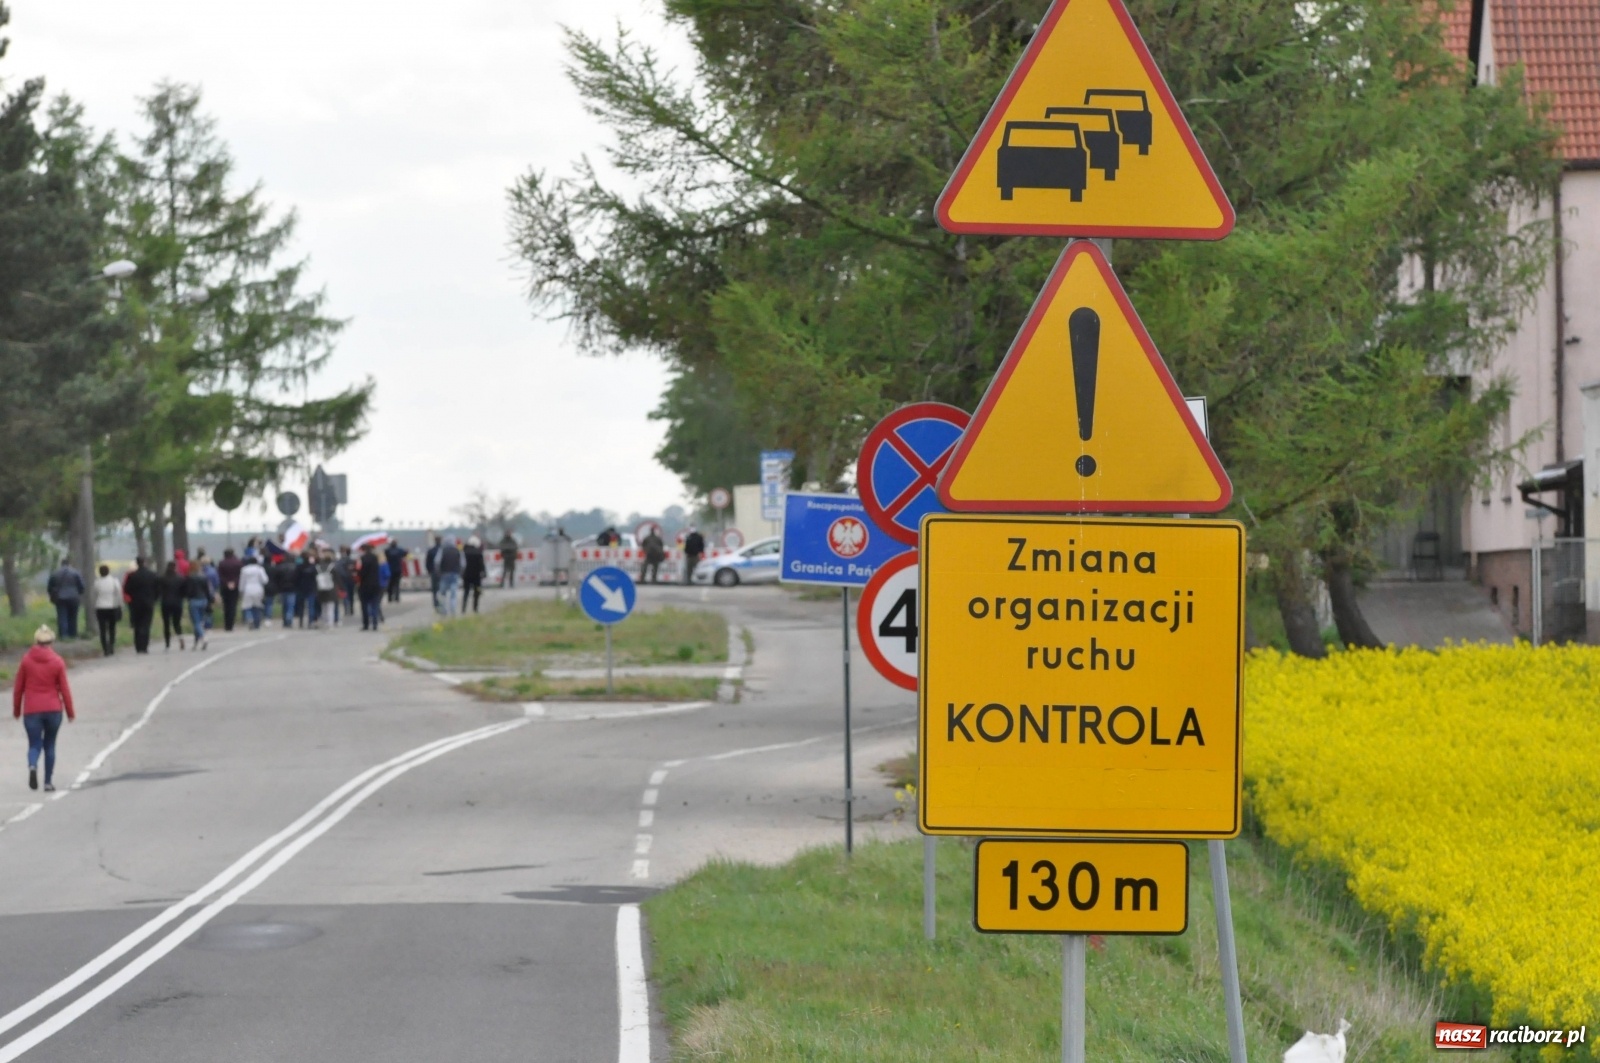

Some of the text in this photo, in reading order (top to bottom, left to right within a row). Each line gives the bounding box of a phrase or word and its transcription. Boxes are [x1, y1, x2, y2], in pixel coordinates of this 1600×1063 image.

[790, 560, 878, 577] Granica Pań
[1007, 538, 1156, 574] Zmiana
[879, 588, 918, 653] 4
[968, 588, 1194, 633] organizacji
[1027, 637, 1135, 671] ruchu
[947, 702, 1206, 747] KONTROLA
[1001, 859, 1159, 912] 130 m
